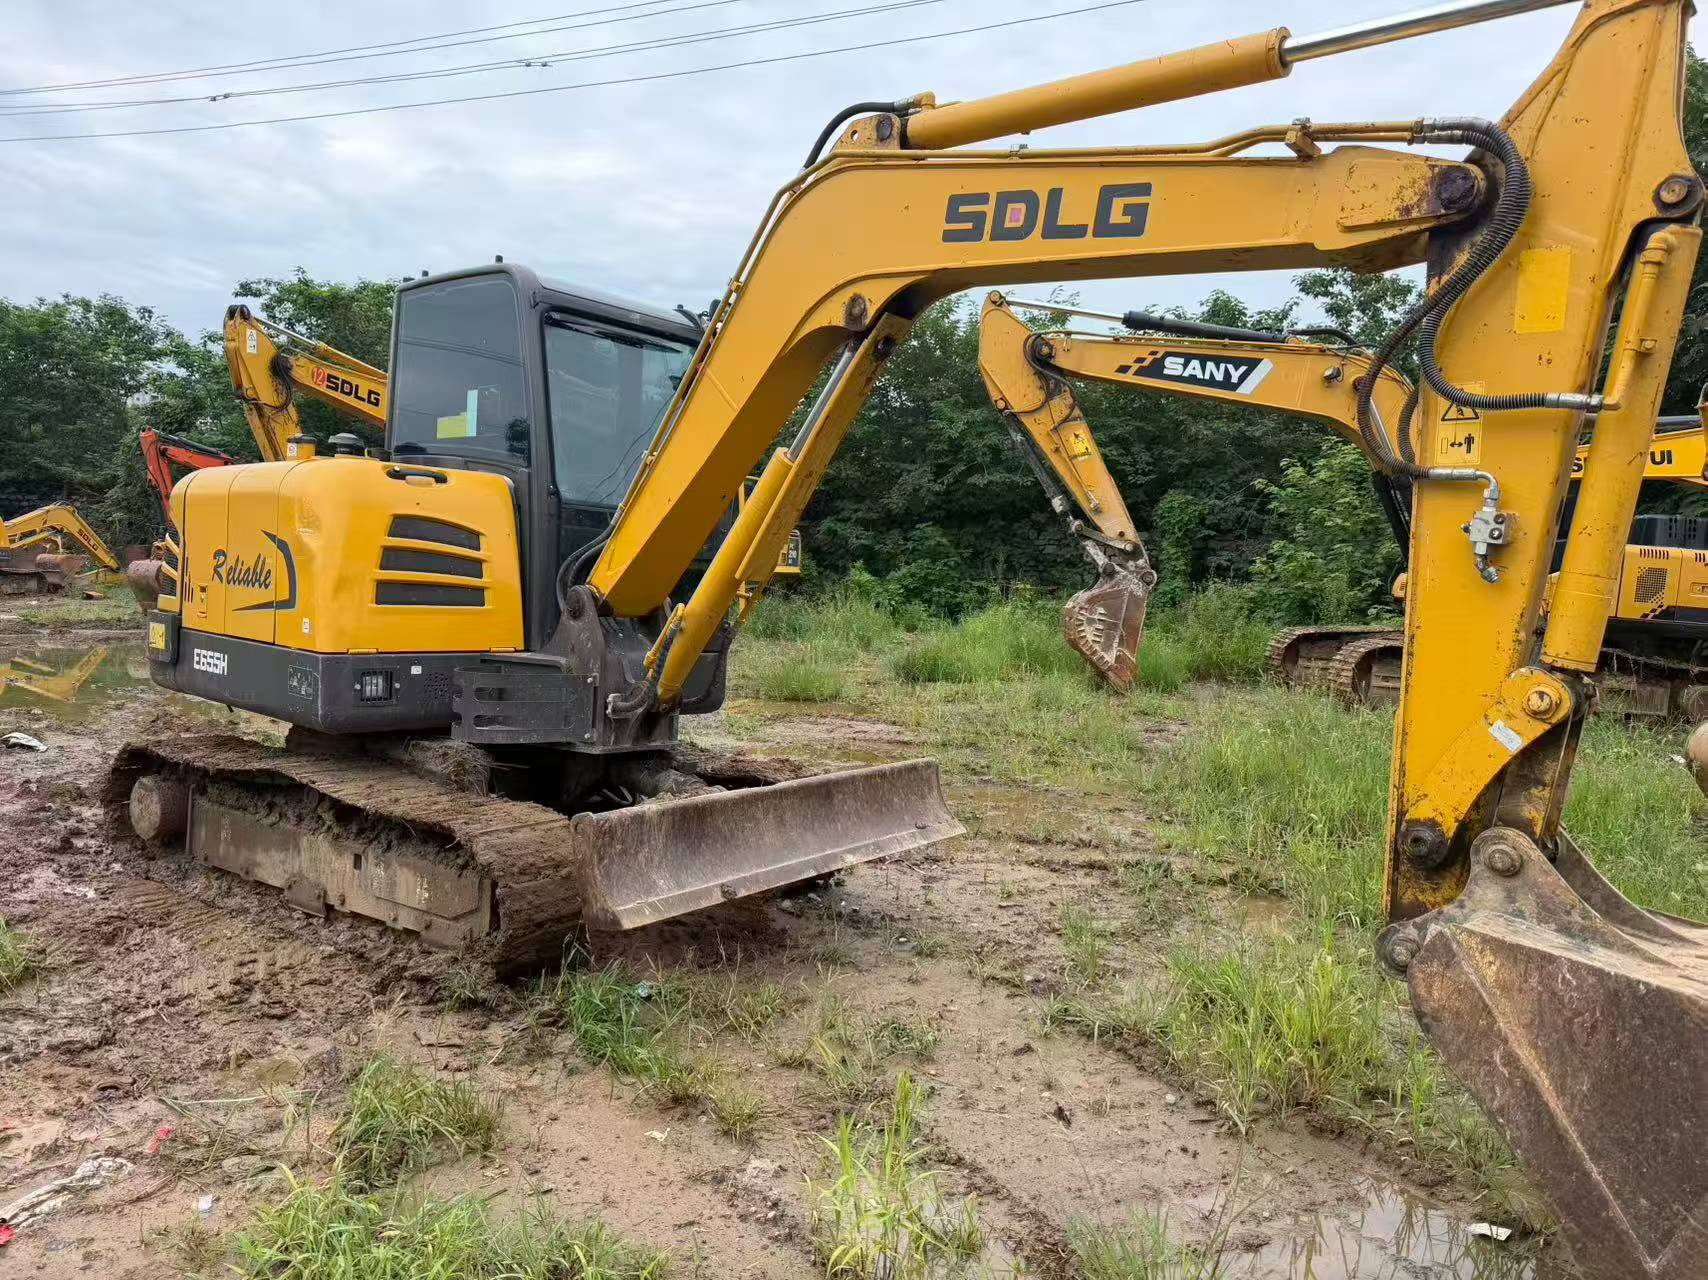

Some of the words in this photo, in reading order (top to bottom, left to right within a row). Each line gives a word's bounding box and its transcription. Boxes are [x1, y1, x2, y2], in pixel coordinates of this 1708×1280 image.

[942, 182, 1152, 243] SDLG
[1163, 356, 1248, 384] SANY
[325, 373, 381, 408] SDLG
[211, 549, 272, 590] Reliable
